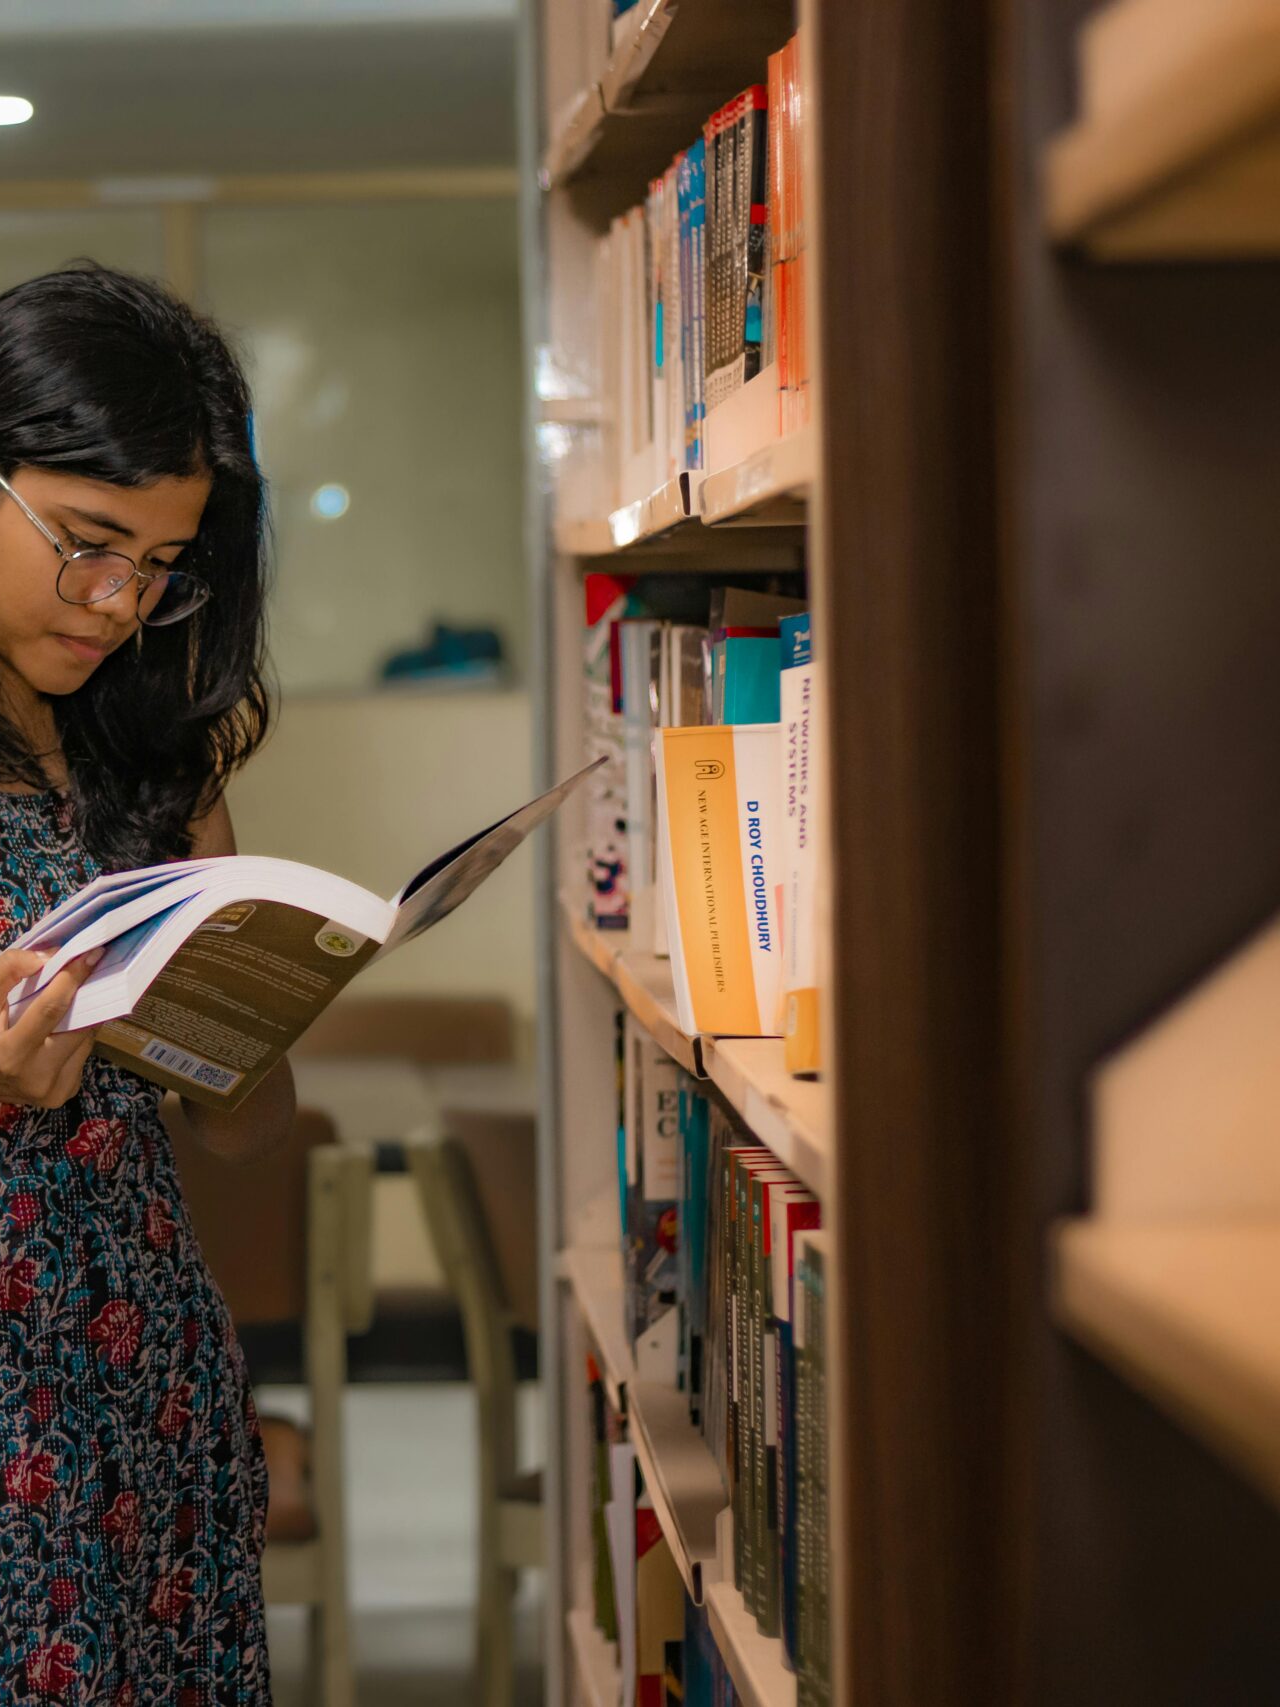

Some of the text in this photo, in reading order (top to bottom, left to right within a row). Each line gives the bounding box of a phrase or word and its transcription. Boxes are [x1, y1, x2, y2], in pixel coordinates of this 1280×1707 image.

[788, 722, 798, 817] SYSTEMS
[799, 678, 811, 849] NETWORKS AND
[697, 790, 726, 993] NEW AGE INTERNATIONAL PUBLISHERS
[747, 801, 771, 952] D ROY CHOUDHURY
[740, 1274, 749, 1373] Computer
[753, 1289, 762, 1391] Computer
[742, 1379, 751, 1468] Graphics
[755, 1396, 764, 1487] Graphics
